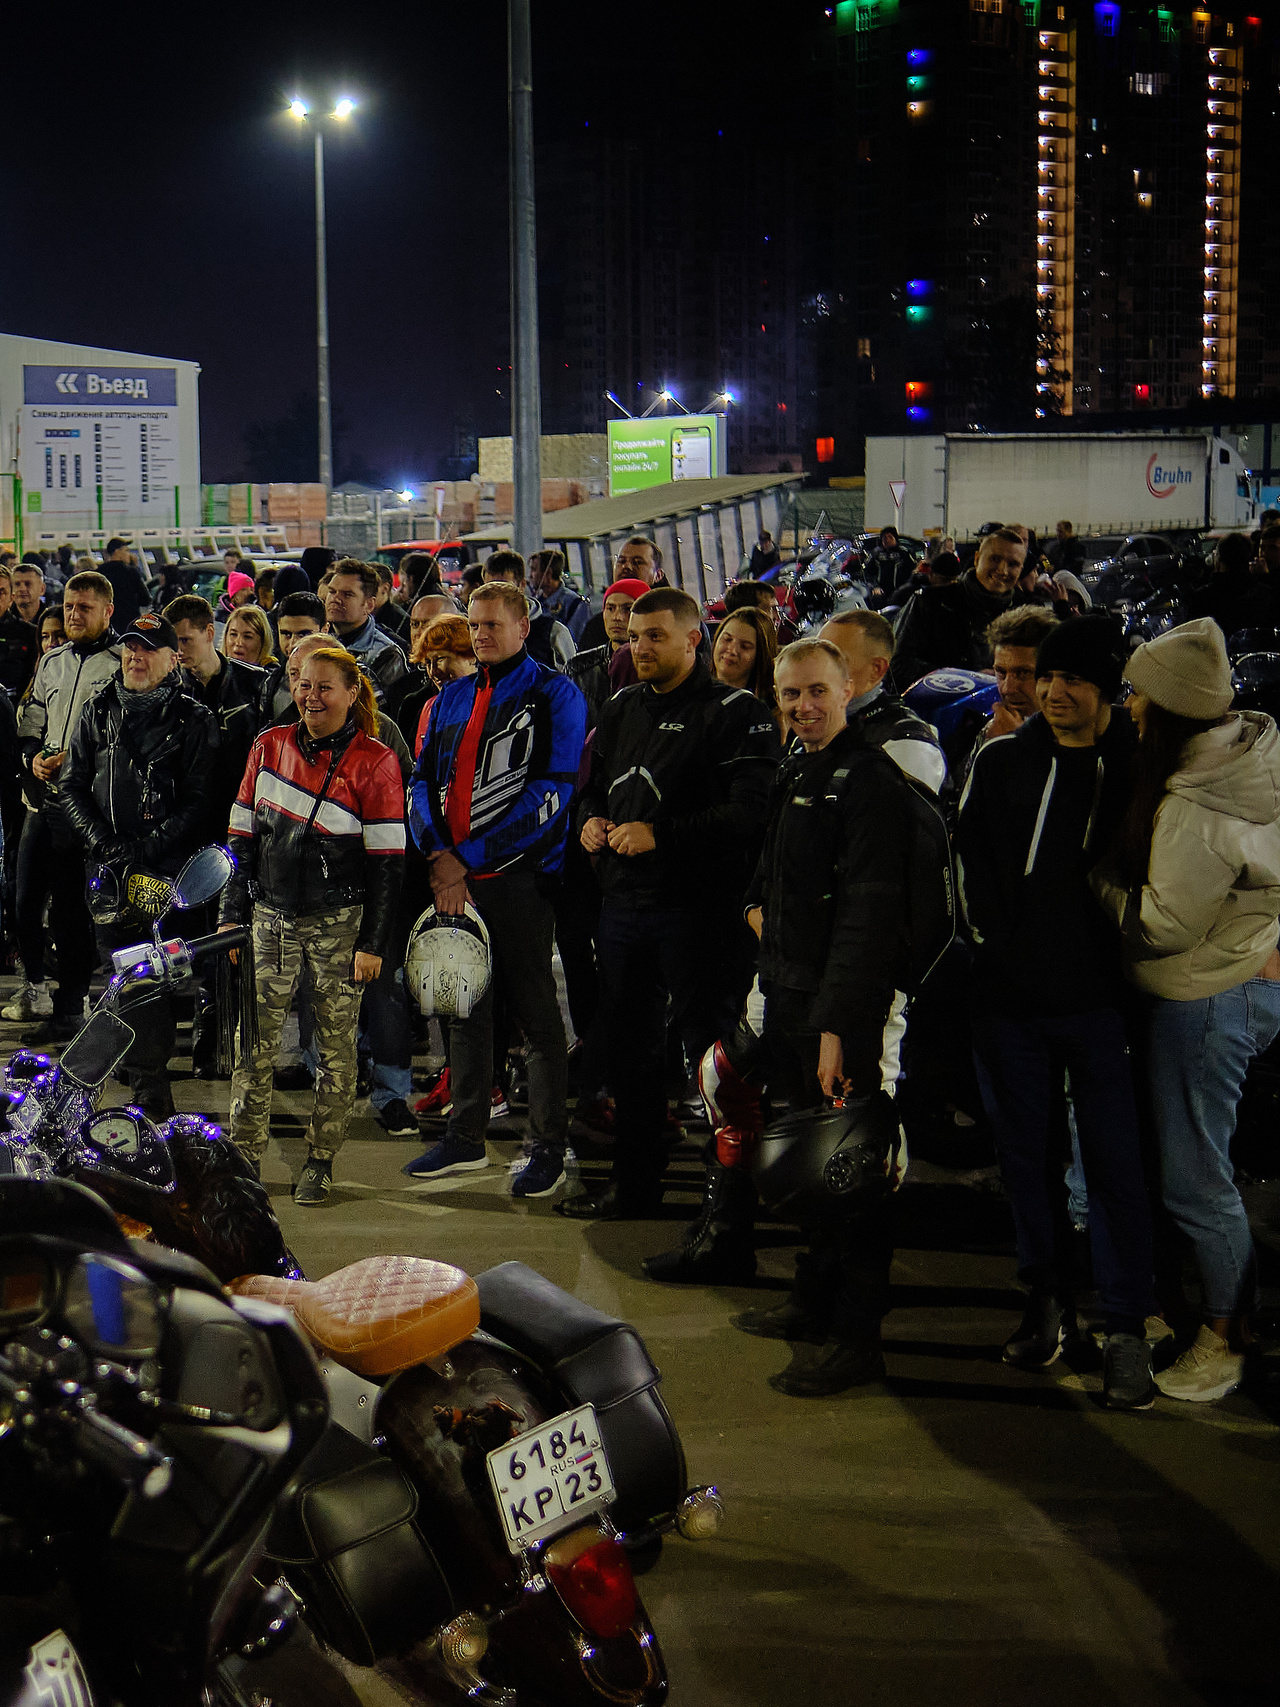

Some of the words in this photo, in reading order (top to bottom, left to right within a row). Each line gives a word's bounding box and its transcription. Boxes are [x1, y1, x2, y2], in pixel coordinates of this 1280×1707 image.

[86, 373, 149, 399] Въезд
[32, 409, 58, 418] Схема
[60, 411, 103, 420] движения
[105, 411, 169, 420] автотранспорта
[1153, 466, 1192, 483] Bruhn
[658, 721, 685, 732] LS2
[748, 723, 773, 735] LS2
[509, 1420, 587, 1480] 6184
[550, 1456, 575, 1477] RUS
[510, 1486, 554, 1532] КР
[565, 1461, 602, 1504] 23
